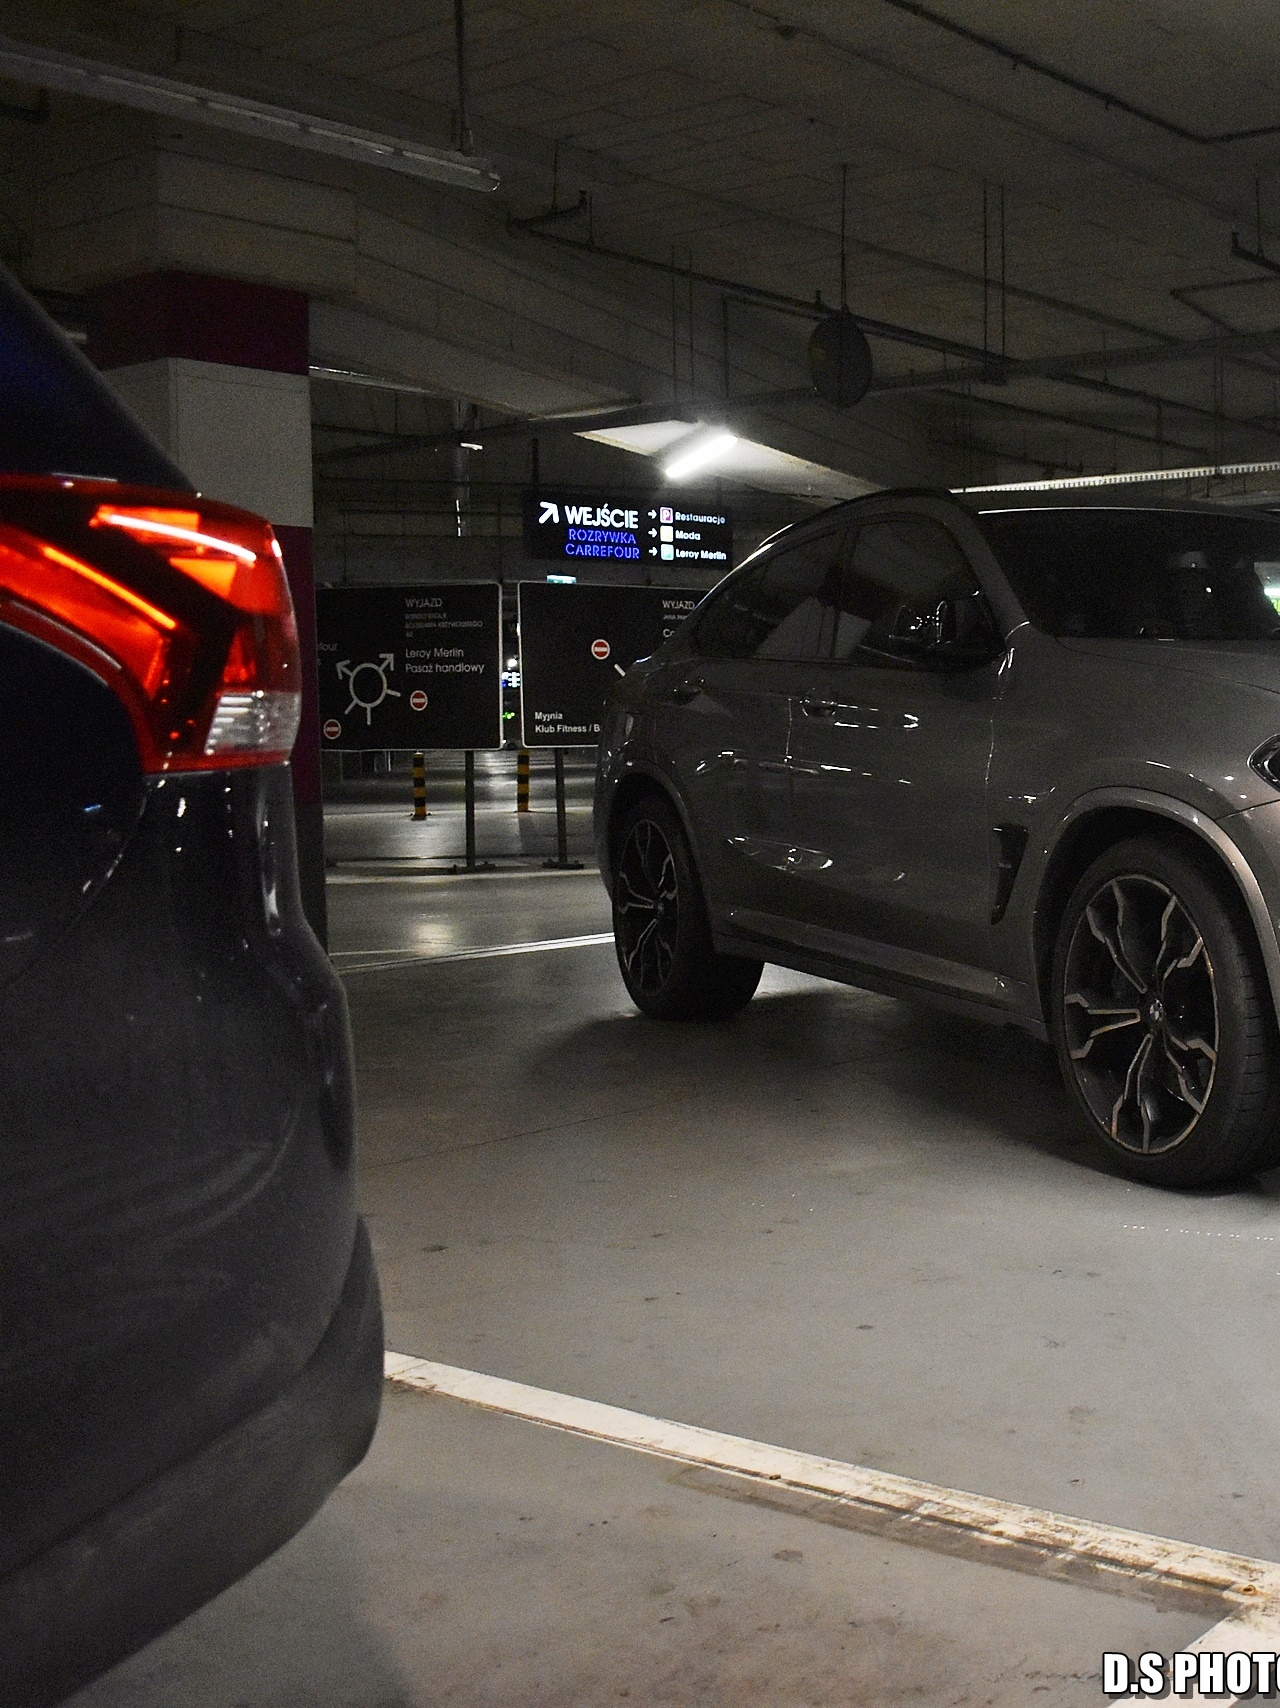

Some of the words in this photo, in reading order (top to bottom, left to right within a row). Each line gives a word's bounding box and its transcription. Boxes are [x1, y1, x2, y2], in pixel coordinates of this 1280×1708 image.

[564, 503, 639, 529] WEJŚCIE
[675, 511, 726, 525] Restauracje
[568, 528, 637, 544] ROZRYWKA
[675, 529, 701, 540] Moda
[565, 543, 640, 559] CARREFOUR
[675, 548, 699, 560] Leroy
[700, 549, 727, 560] Merlin
[405, 598, 442, 608] WYJAZD
[662, 600, 695, 610] WYJAZD
[405, 648, 431, 660] Leroy
[434, 647, 464, 658] Merlin
[405, 661, 433, 673] Pasaż
[435, 660, 485, 674] handlowy
[534, 711, 563, 721] Myjnia
[535, 724, 555, 733] Klub
[557, 723, 587, 733] Fitness
